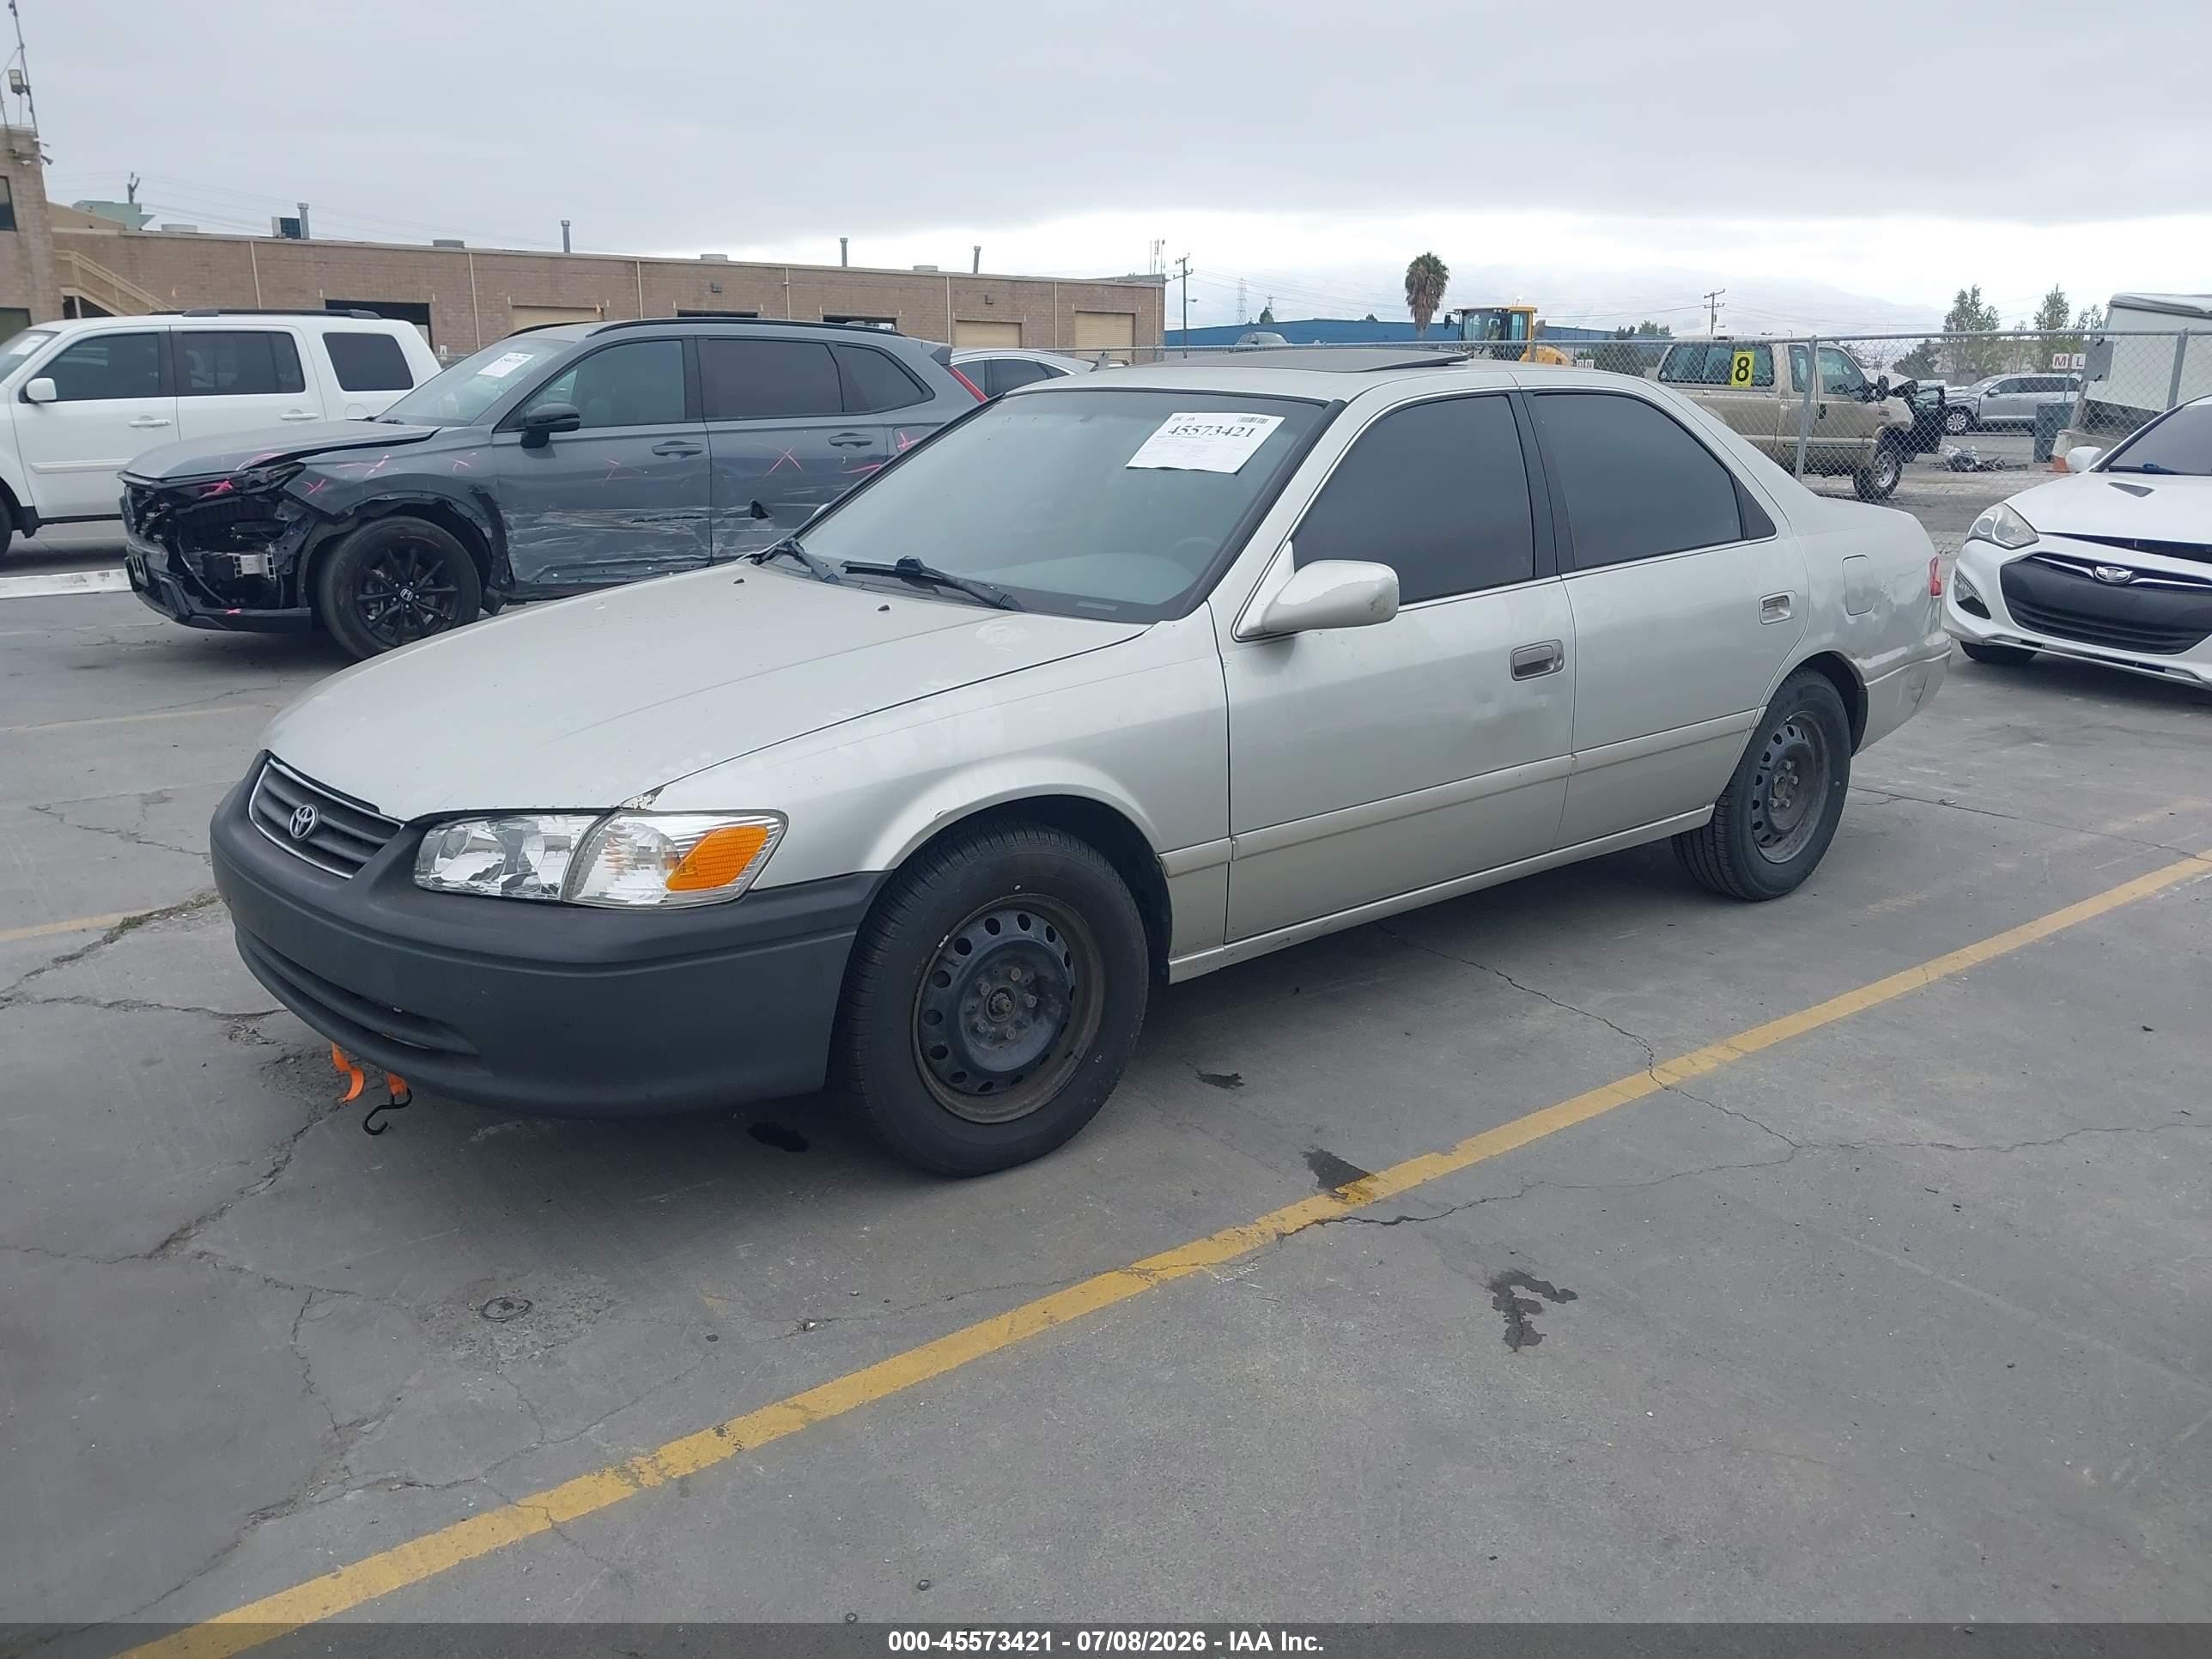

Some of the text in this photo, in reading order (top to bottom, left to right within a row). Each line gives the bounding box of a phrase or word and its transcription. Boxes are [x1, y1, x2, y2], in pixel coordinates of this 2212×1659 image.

[2054, 356, 2084, 367] M L
[1735, 356, 1750, 382] 8
[1168, 425, 1256, 438] 45573421
